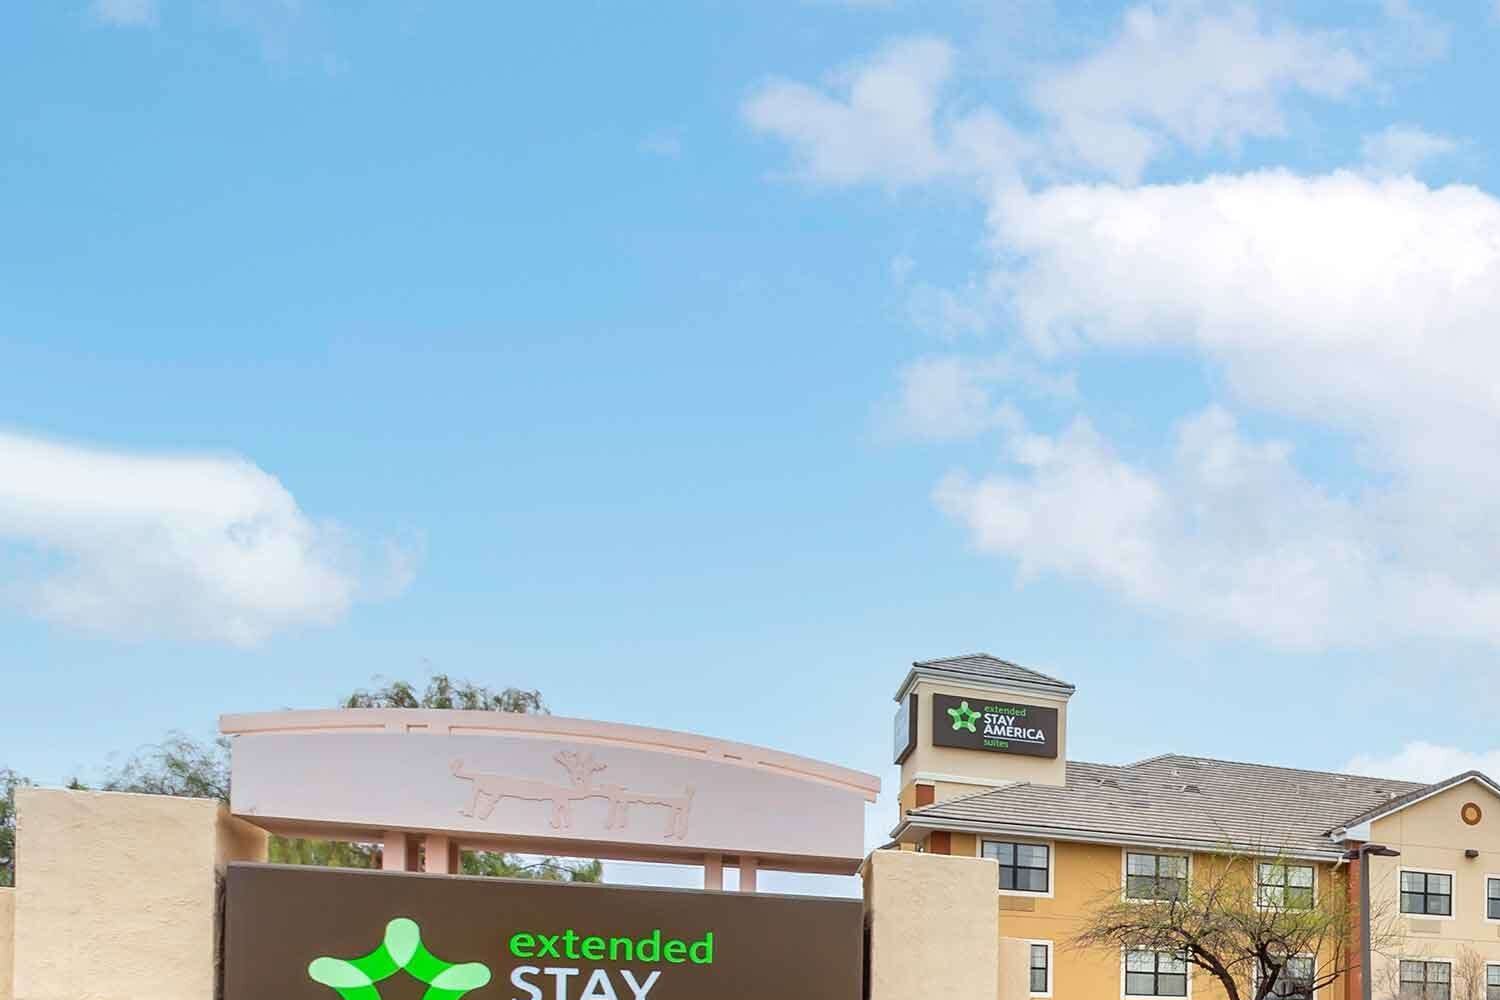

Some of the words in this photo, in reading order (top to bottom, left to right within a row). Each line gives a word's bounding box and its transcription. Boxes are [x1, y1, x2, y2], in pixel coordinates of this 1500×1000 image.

[984, 705, 1026, 717] extended
[984, 713, 1015, 726] STAY
[984, 724, 1045, 741] AMERICA
[984, 739, 1009, 748] suites
[509, 928, 714, 964] extended
